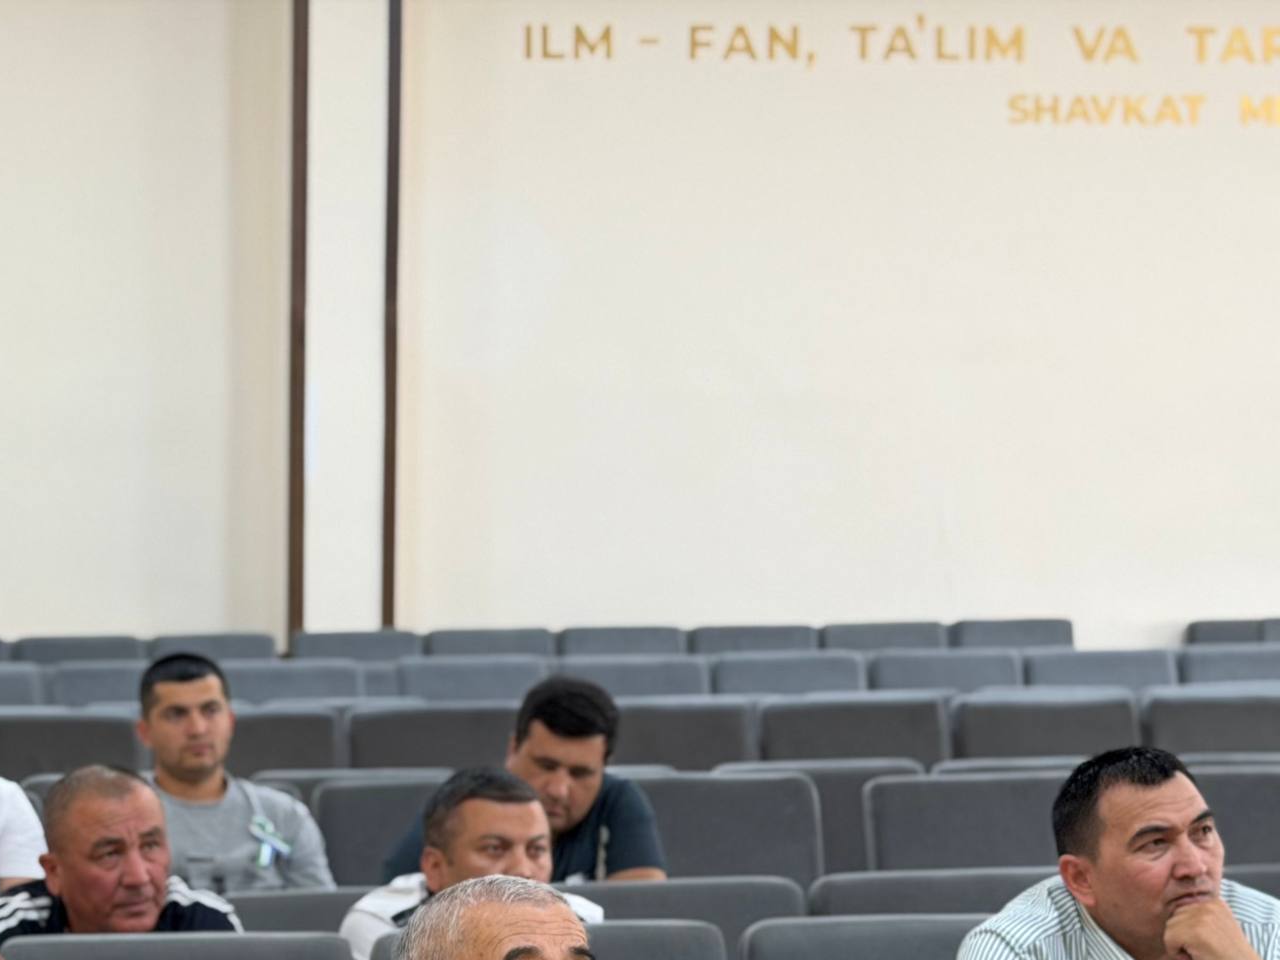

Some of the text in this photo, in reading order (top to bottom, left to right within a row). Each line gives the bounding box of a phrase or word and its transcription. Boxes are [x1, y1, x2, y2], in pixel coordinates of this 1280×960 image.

[523, 24, 614, 60] ILM
[688, 24, 817, 67] FAN,
[1072, 25, 1140, 64] VA
[1007, 94, 1207, 126] SHAVKAT
